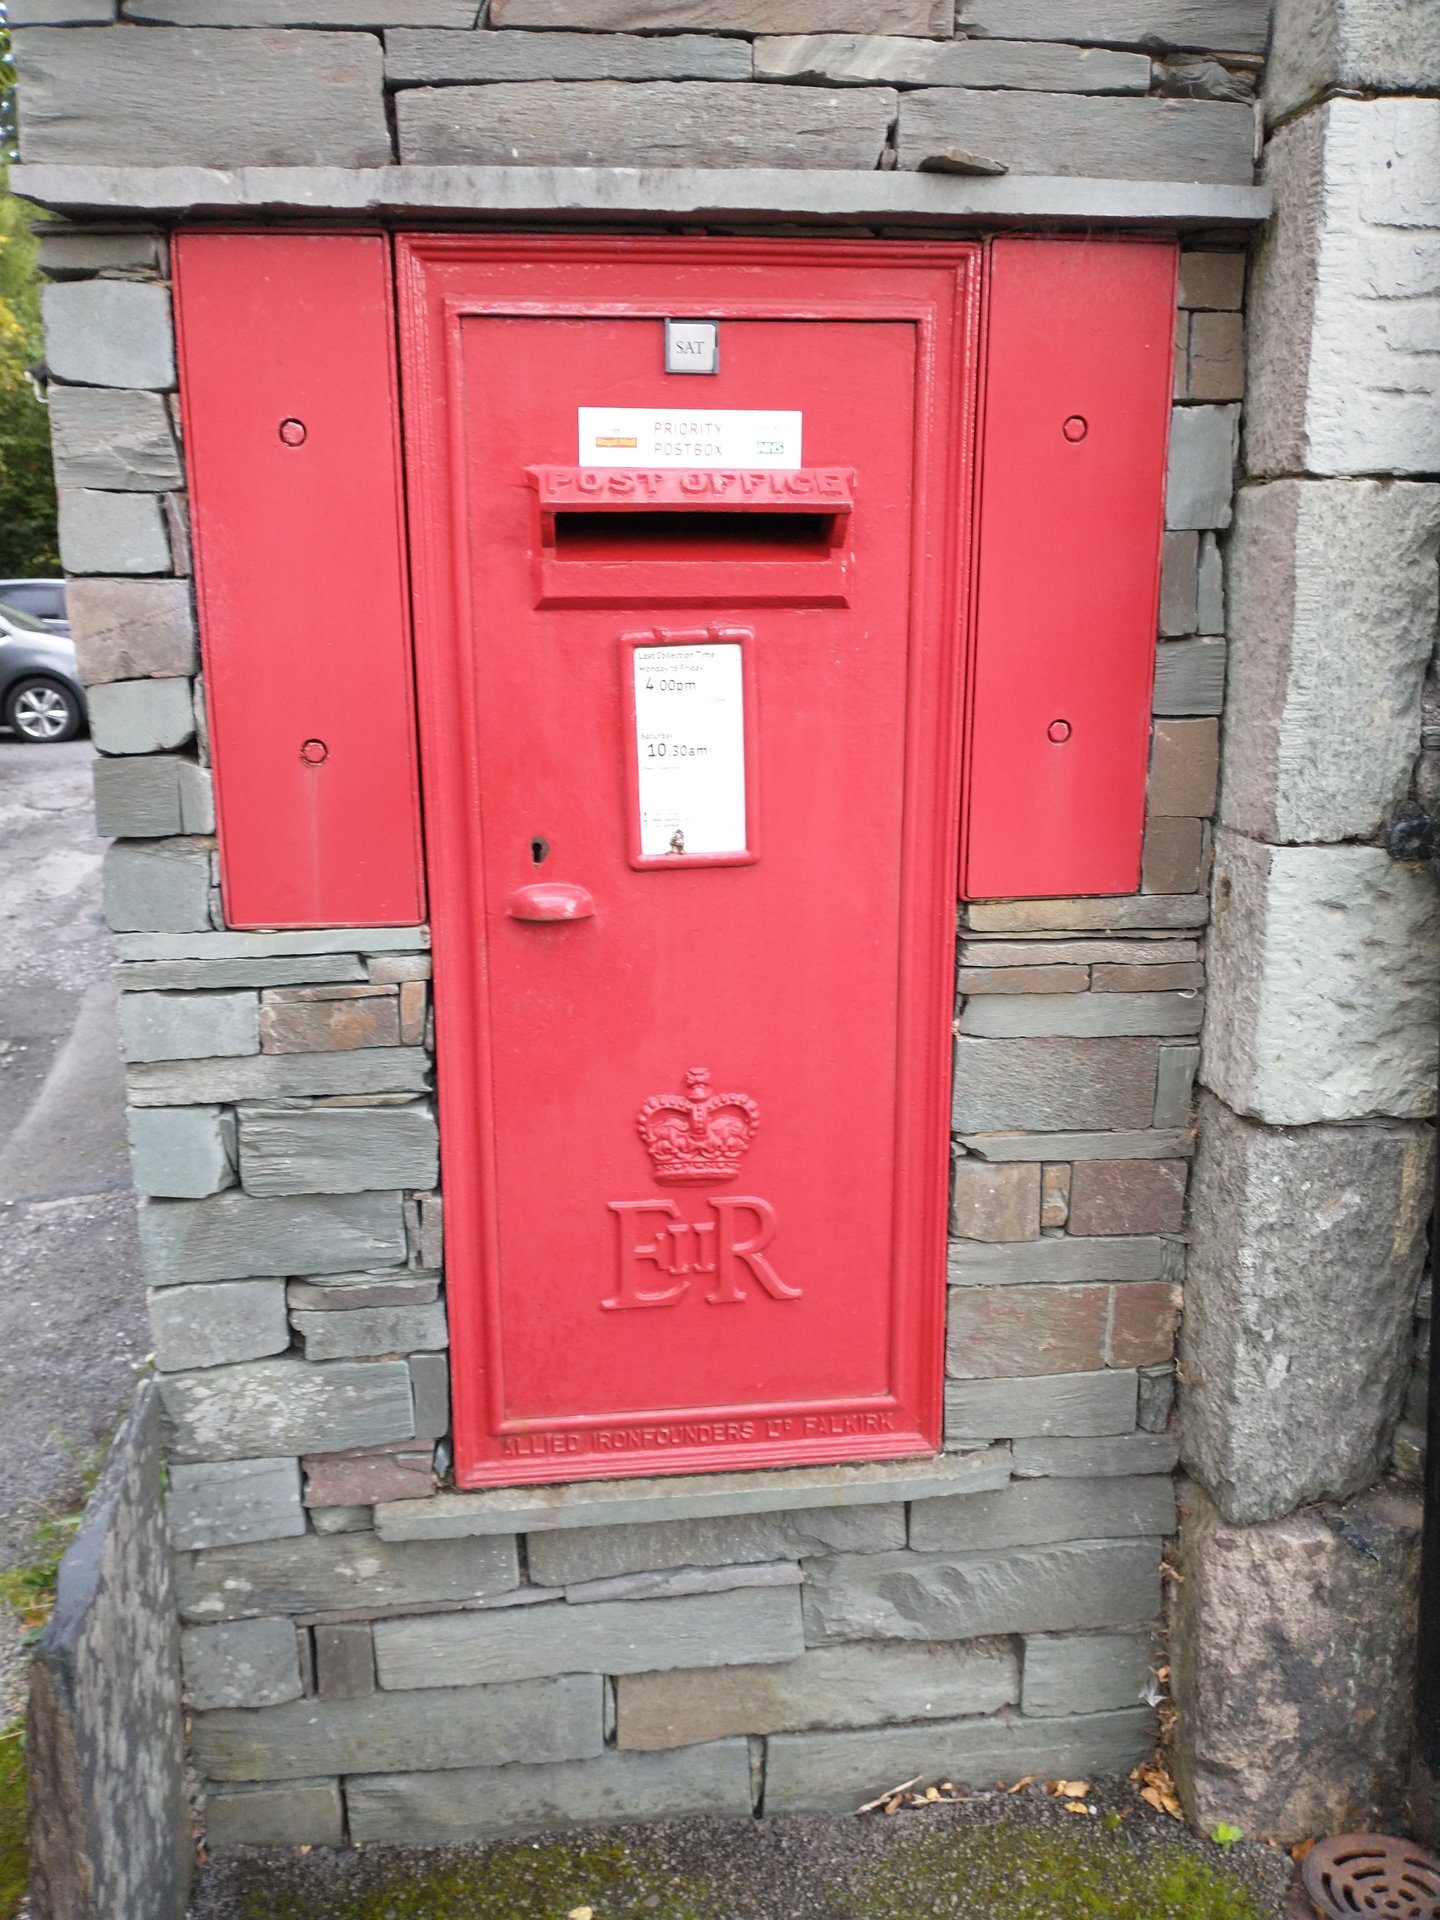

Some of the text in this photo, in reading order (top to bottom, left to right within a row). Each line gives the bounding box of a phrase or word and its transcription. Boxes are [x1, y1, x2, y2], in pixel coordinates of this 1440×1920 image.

[675, 340, 705, 356] SAT
[653, 422, 723, 436] PRIORITY
[653, 443, 724, 456] POSTBOX
[546, 471, 844, 496] POST OFFICE
[638, 652, 655, 660] Last
[657, 651, 694, 659] Collection
[638, 665, 668, 673] Monday
[680, 664, 703, 672] Friday
[645, 677, 697, 693] 4.00pm
[646, 742, 708, 758] 10.30am
[504, 1432, 580, 1456] ALLIED
[591, 1421, 755, 1450] IRONFOUNDERS
[803, 1412, 895, 1436] FALKIRK
